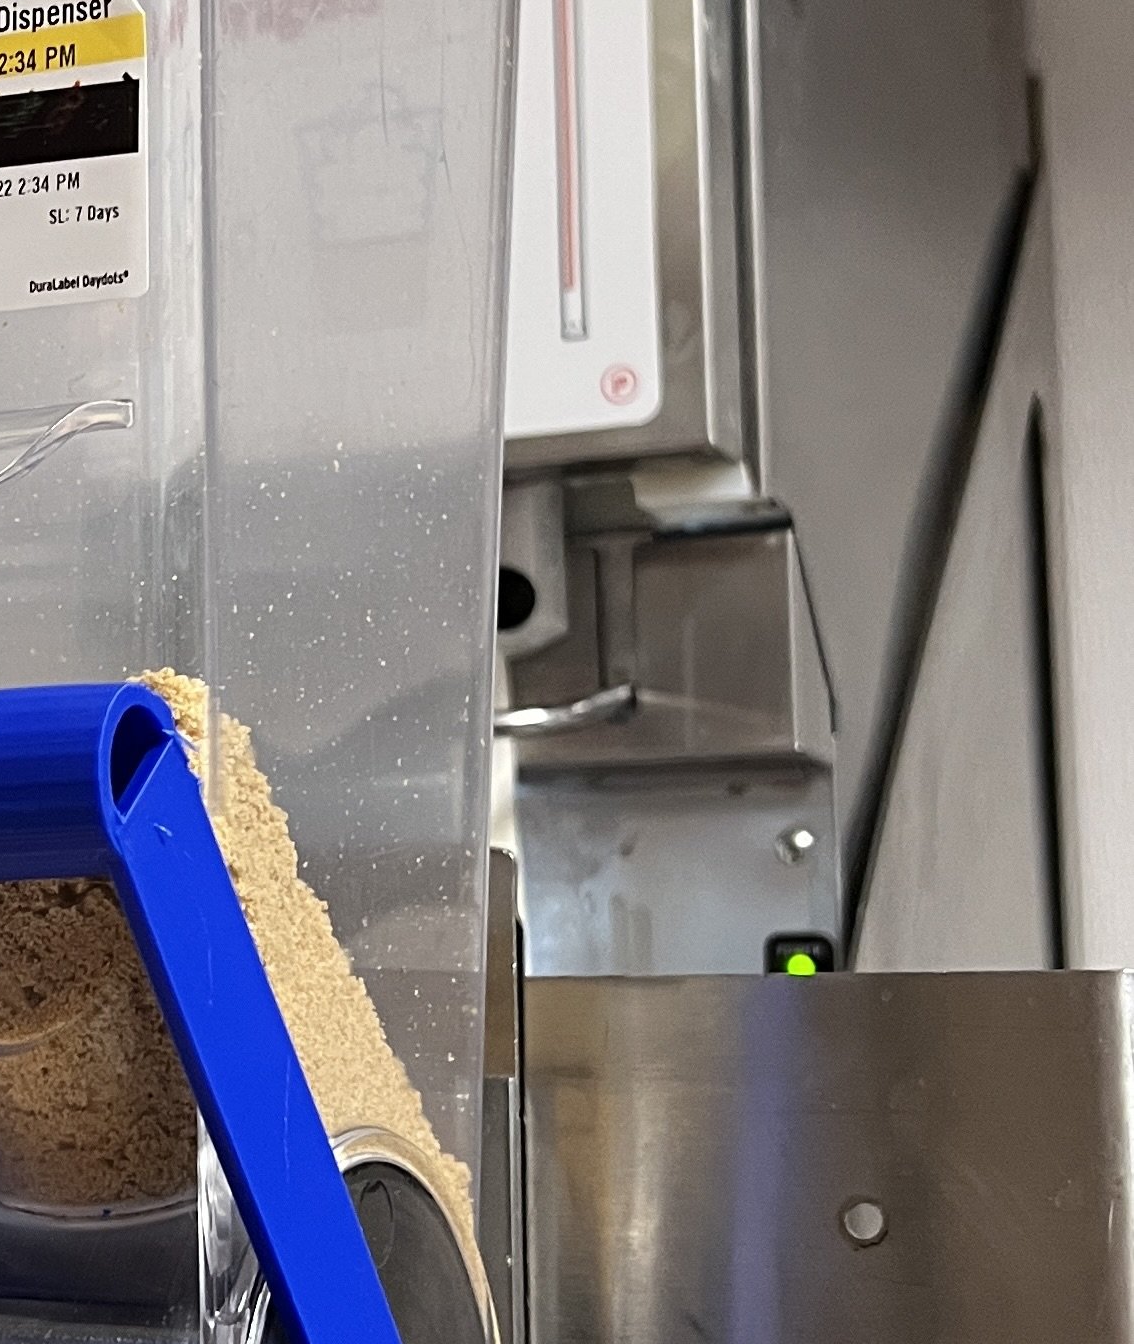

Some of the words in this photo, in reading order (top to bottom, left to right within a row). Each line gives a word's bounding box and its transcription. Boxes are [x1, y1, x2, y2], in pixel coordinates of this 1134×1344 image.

[45, 44, 76, 69] PM
[18, 176, 49, 196] 2:34
[57, 172, 80, 192] PM
[49, 208, 70, 225] SL:
[75, 206, 82, 222] 7
[87, 204, 119, 224] Days
[29, 276, 79, 293] DuraLabel
